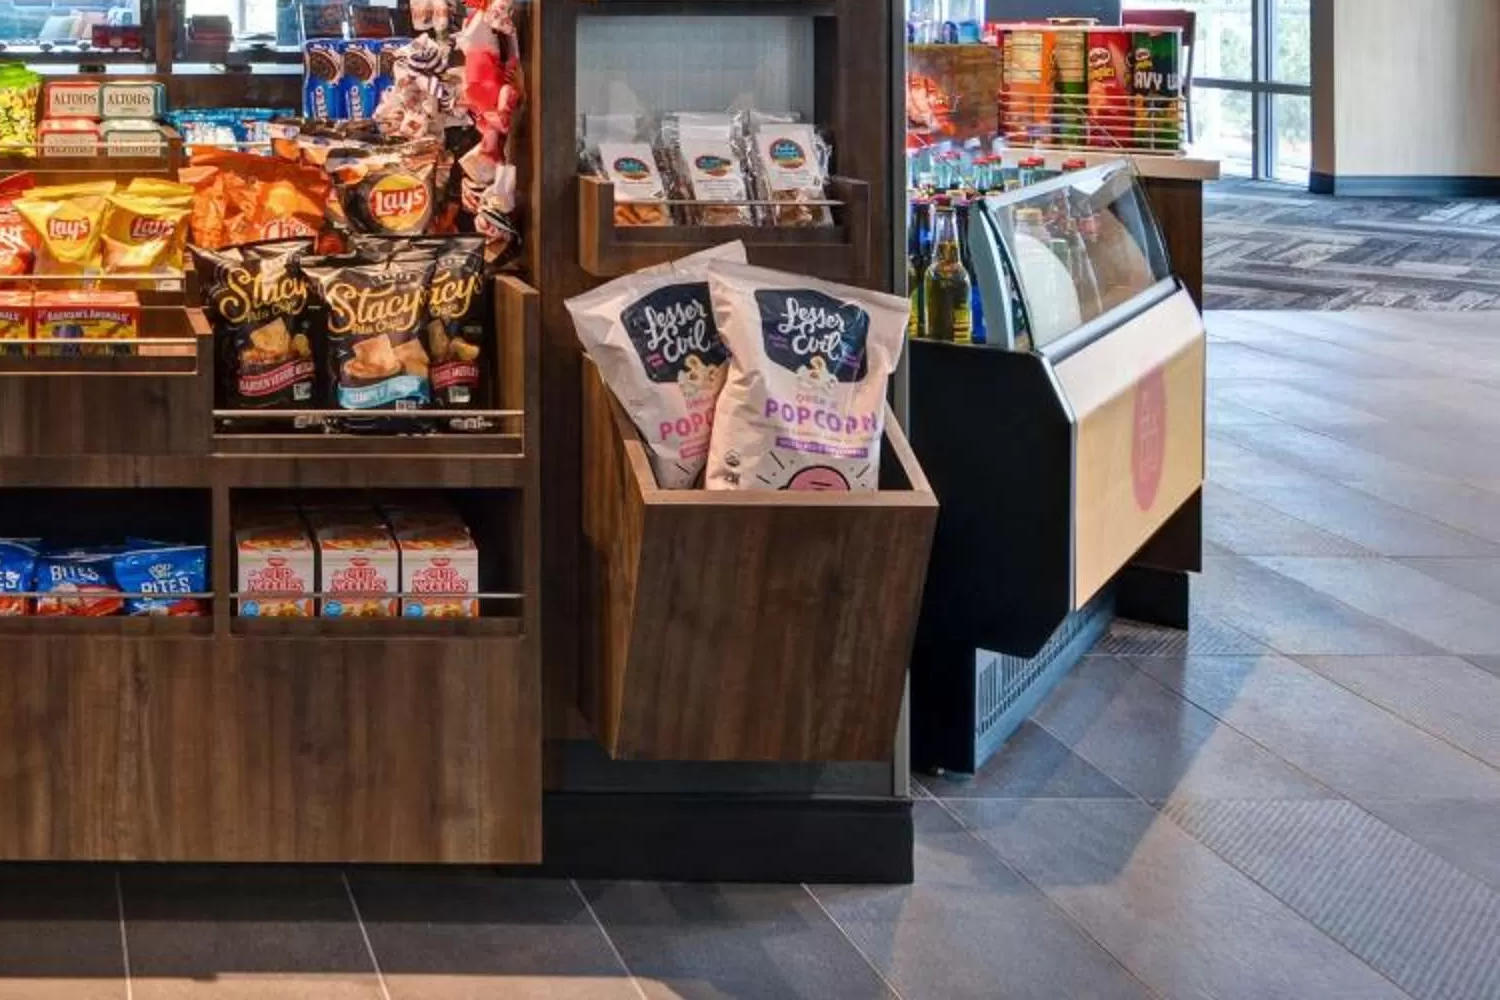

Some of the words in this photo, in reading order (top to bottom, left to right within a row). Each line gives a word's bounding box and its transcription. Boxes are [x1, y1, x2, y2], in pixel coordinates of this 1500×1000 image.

[1133, 71, 1163, 91] AVY
[53, 93, 97, 106] ALTOIDS
[107, 93, 151, 106] ALTOIDS
[764, 397, 878, 435] POPCORN
